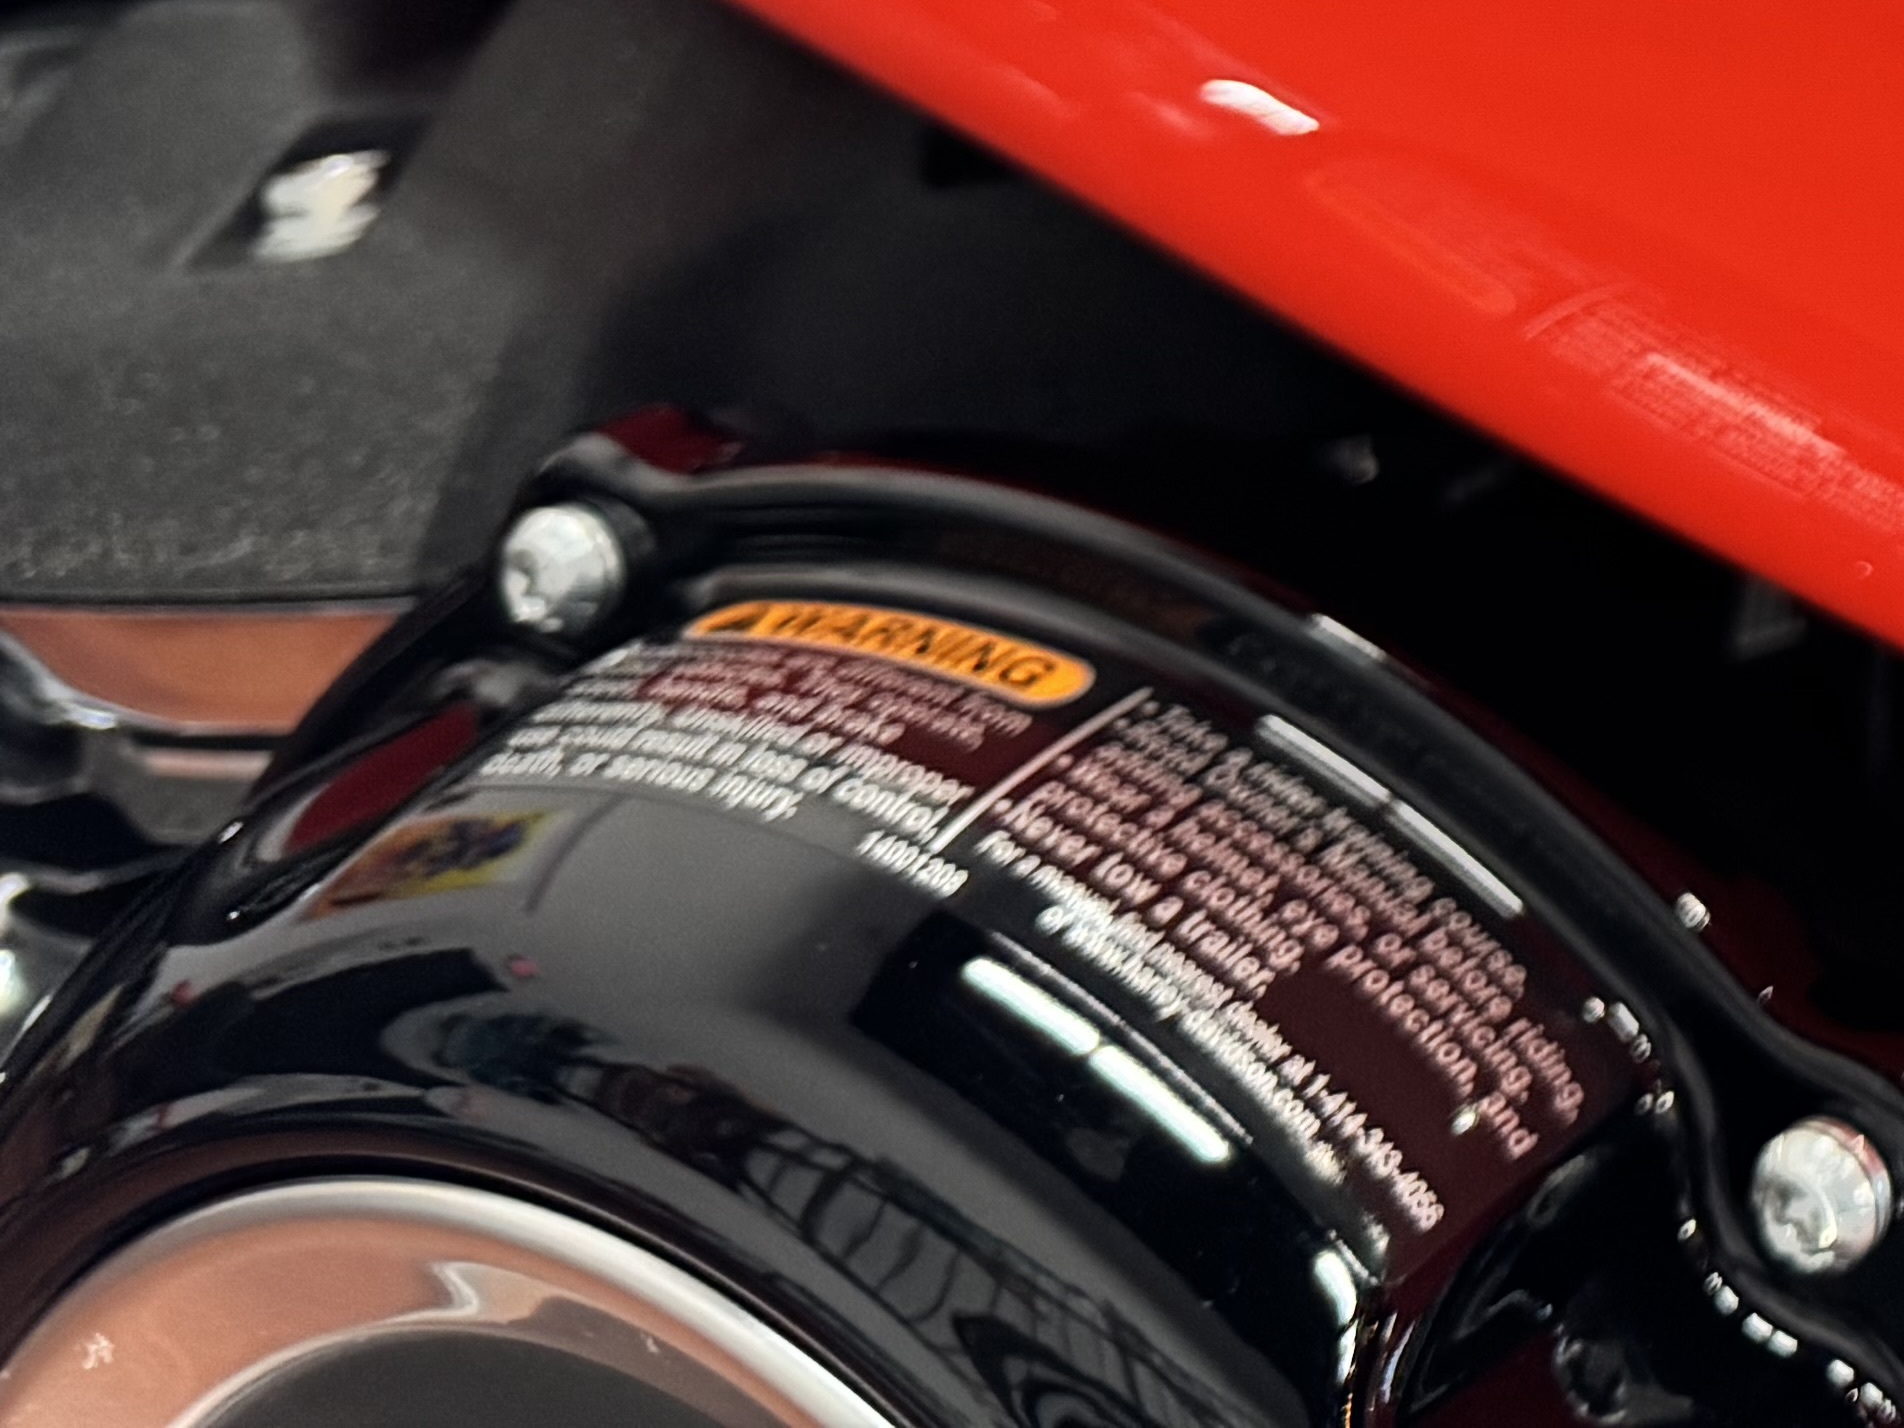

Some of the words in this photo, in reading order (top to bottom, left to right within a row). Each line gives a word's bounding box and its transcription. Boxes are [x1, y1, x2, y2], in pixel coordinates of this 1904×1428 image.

[770, 606, 1056, 690] WARNING
[472, 749, 578, 778] death,
[558, 750, 611, 778] or
[596, 753, 721, 793] serious
[667, 702, 814, 747] Unskilled
[786, 729, 850, 759] or
[827, 741, 979, 807] improper
[743, 690, 824, 723] and
[803, 700, 911, 746] brake
[951, 691, 1039, 738] from
[551, 725, 646, 749] could
[624, 728, 726, 759] result
[699, 738, 753, 766] in
[734, 741, 813, 784] loss
[790, 764, 853, 795] of
[823, 776, 958, 844] control,
[1157, 701, 1232, 756] Take
[1222, 742, 1256, 771] a
[1245, 756, 1329, 821] rider
[1317, 802, 1439, 907] training
[850, 828, 973, 898] 14001208
[999, 796, 1104, 873] Never
[1091, 848, 1163, 908] tow
[1145, 890, 1186, 927] a
[1172, 904, 1284, 1002] trailer.
[1026, 776, 1192, 881] protective
[1177, 861, 1316, 979] clothing.
[1032, 901, 1078, 935] or
[1063, 753, 1153, 820] Wear
[1139, 799, 1179, 832] a
[1166, 811, 1289, 910] helmet,
[1273, 894, 1343, 953] eye
[1321, 938, 1487, 1098] protection,
[1474, 1087, 1541, 1164] and
[1192, 794, 1381, 943] accessories,
[1368, 927, 1420, 978] or
[1405, 960, 1542, 1106] servicing.
[1314, 837, 1434, 941] Manual
[1415, 921, 1517, 1028] before
[972, 825, 1028, 869] For
[1008, 849, 1043, 880] a
[1141, 937, 1236, 1013] nearest
[1219, 994, 1296, 1069] dealer
[1274, 1047, 1319, 1088] at
[1300, 1068, 1449, 1234] 1-414-343-4056
